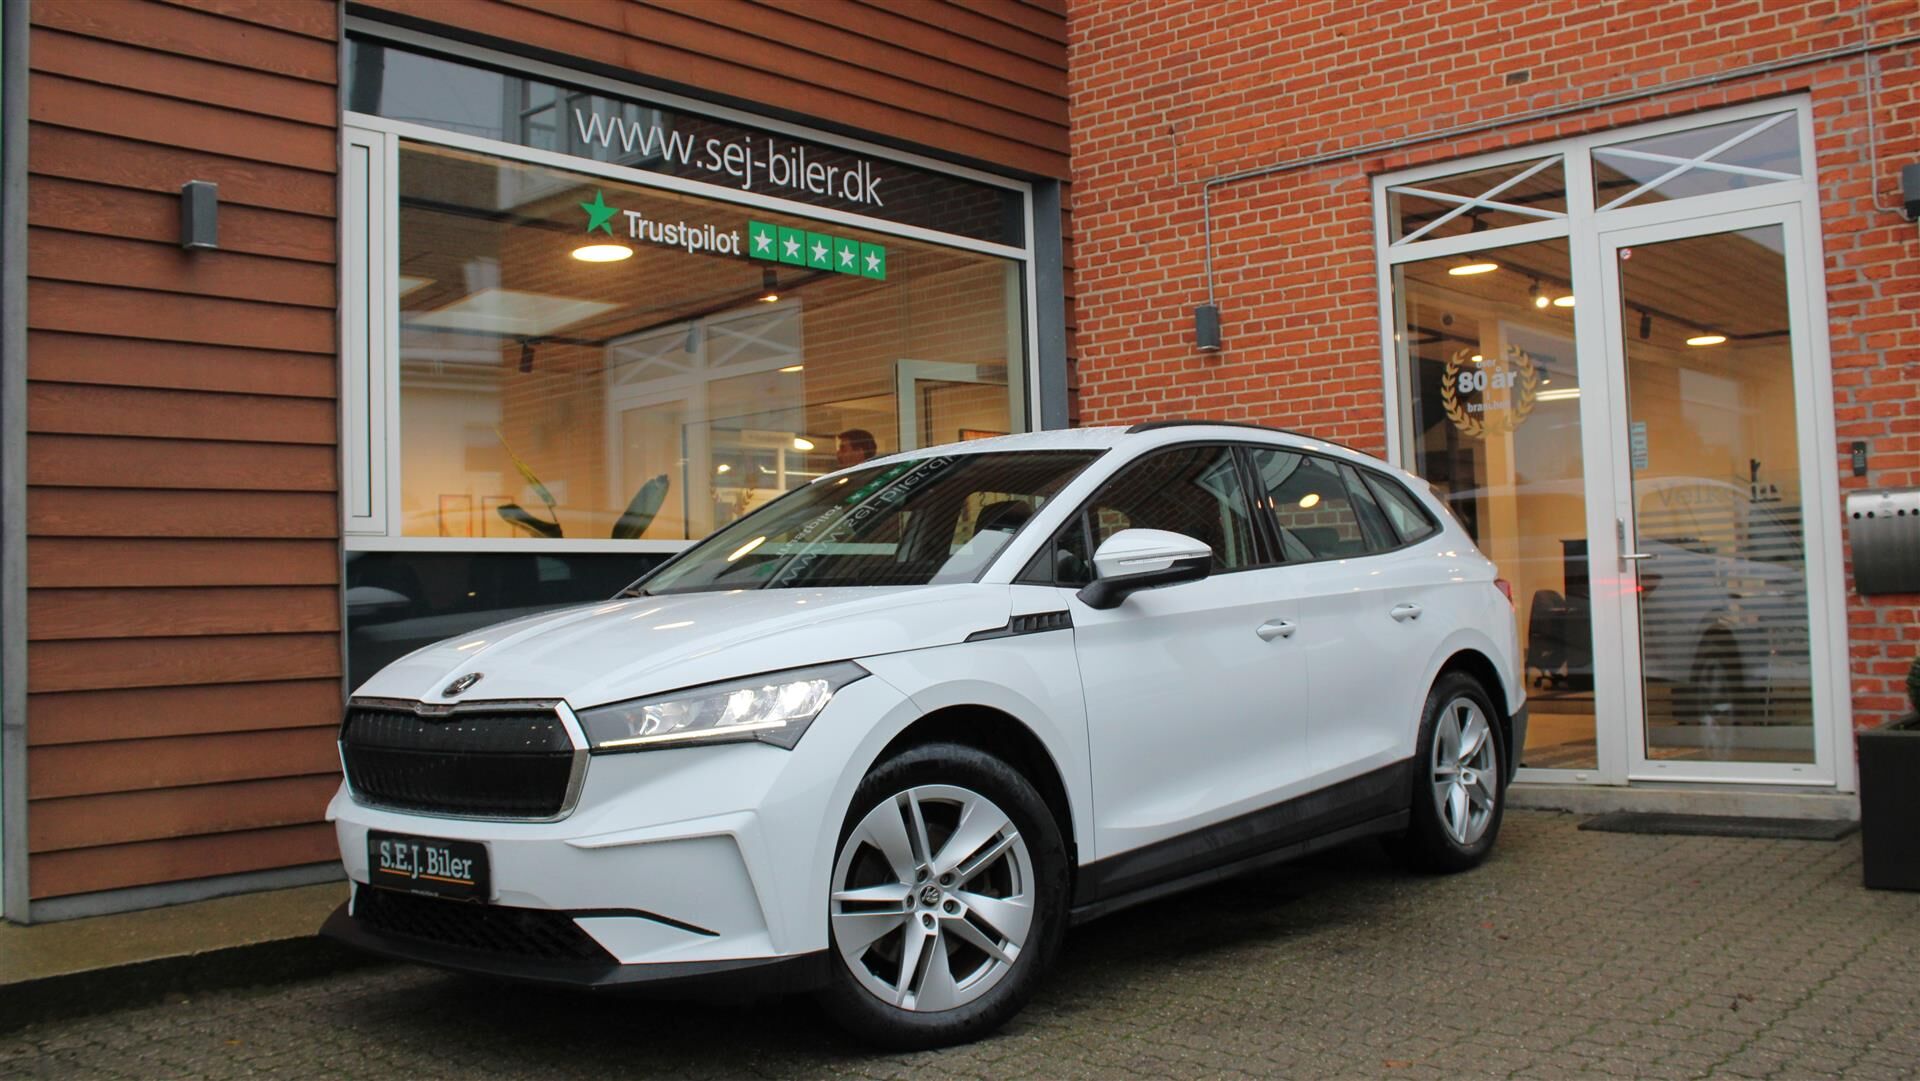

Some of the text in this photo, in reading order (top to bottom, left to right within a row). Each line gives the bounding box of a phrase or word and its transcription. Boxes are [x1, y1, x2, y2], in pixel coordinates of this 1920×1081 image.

[575, 108, 884, 207] www.sej-biler.dk
[623, 209, 741, 256] Trustpilot
[1458, 366, 1518, 393] 80 år
[380, 841, 473, 879] S.E.J. Biler
